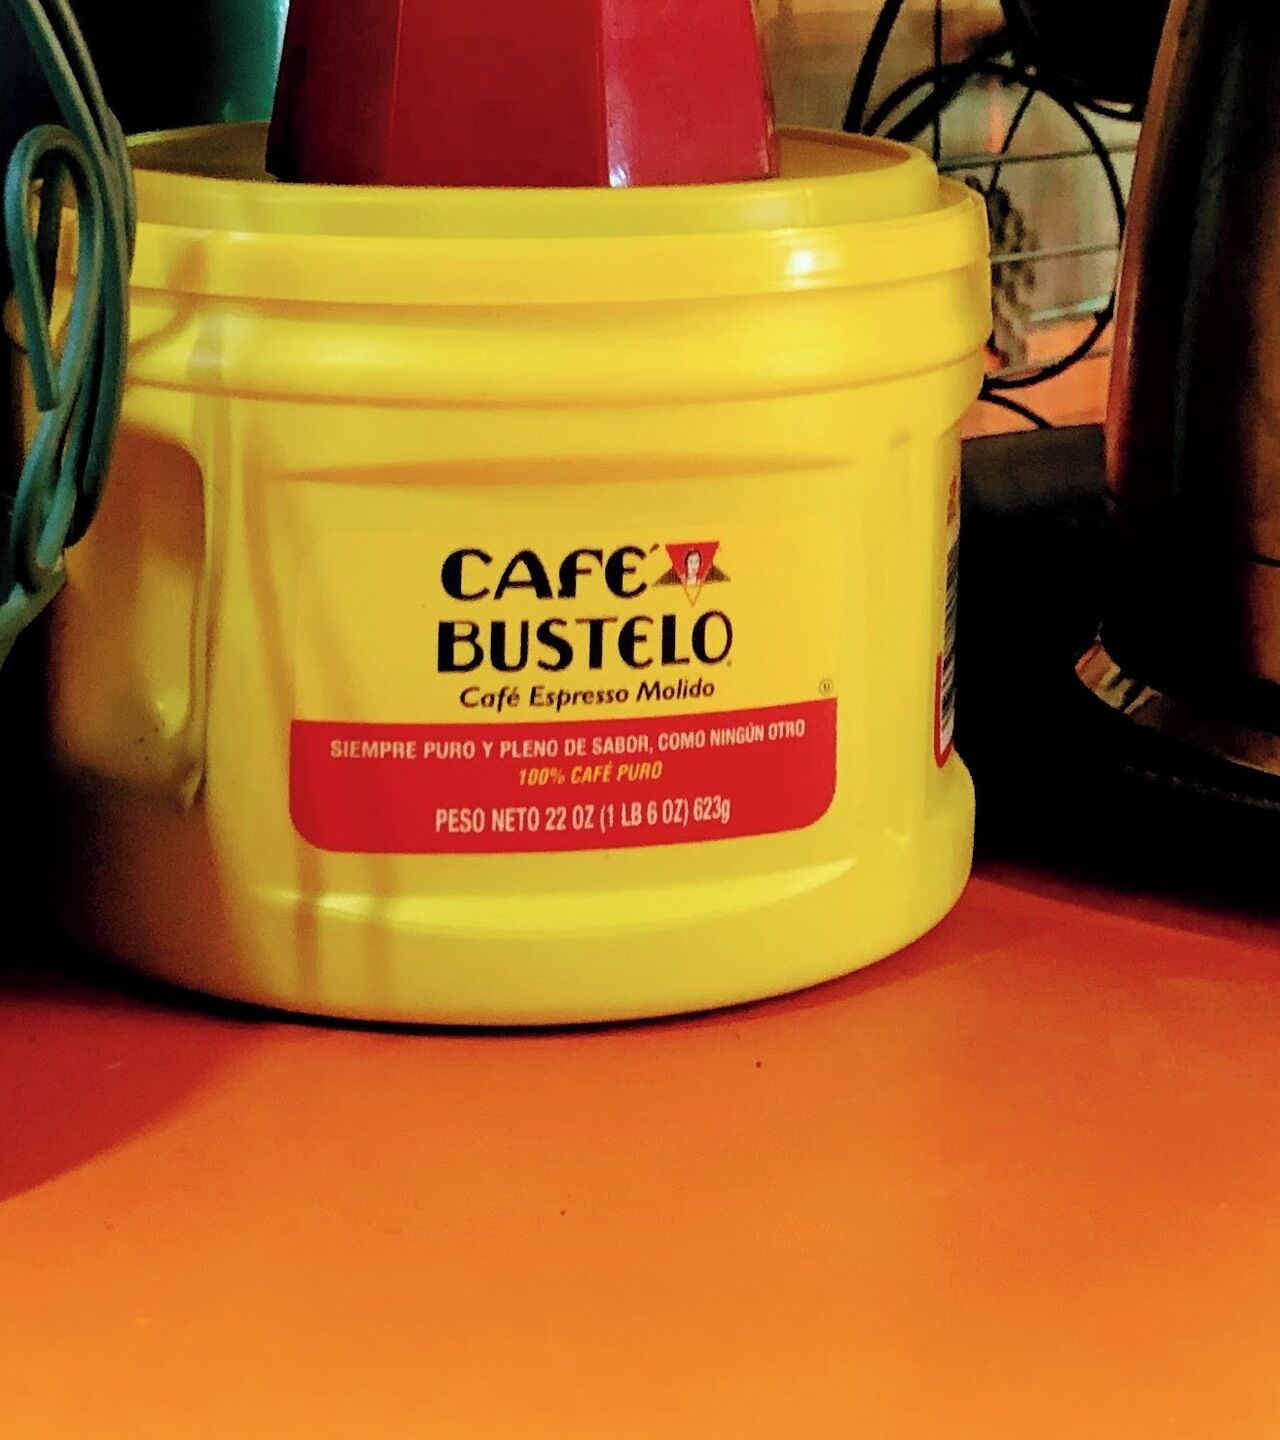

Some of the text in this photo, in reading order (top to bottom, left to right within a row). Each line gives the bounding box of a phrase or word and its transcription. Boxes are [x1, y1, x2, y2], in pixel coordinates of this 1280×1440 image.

[437, 611, 733, 674] BUSTELO
[458, 677, 716, 713] Café Espresso Molido
[330, 718, 806, 760] SIEMPRE PURO Y PLENO DE SABOR, COMO NINGÚN OTRO
[518, 760, 663, 787] 100% CAFÉ PURO
[435, 794, 732, 834] PESO NETO 22 OZ (1 LB 6 OZ) 623g
